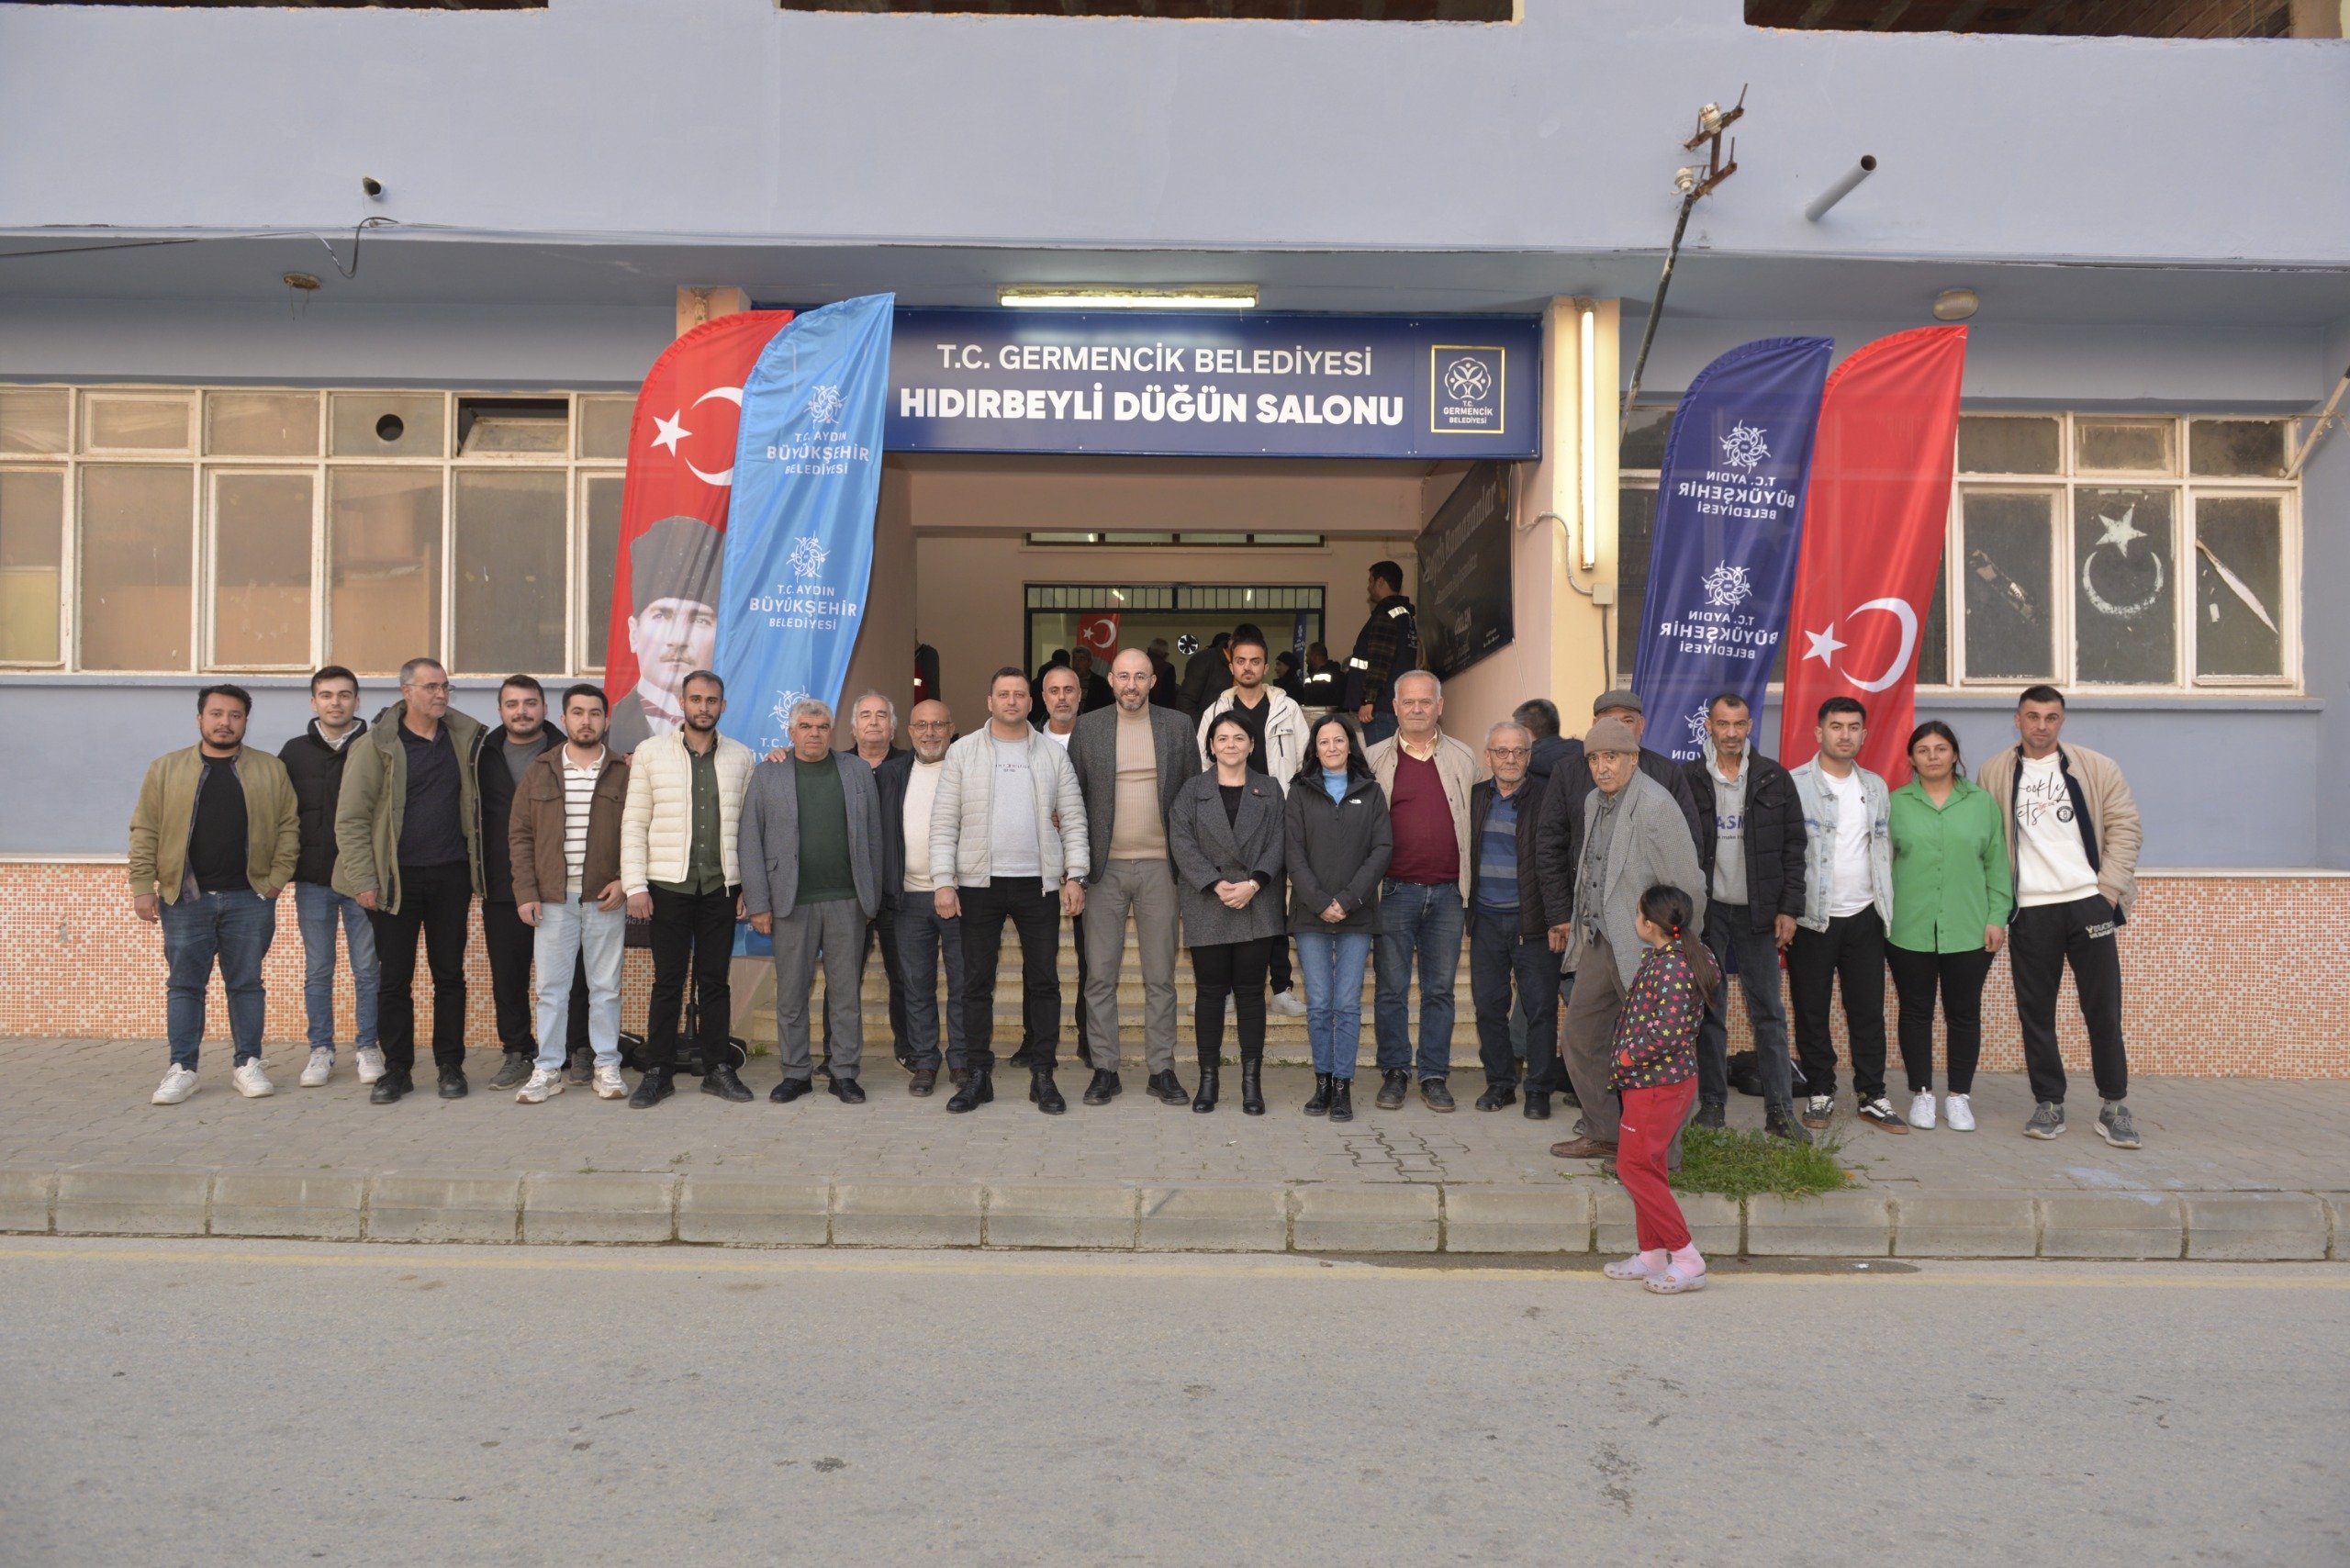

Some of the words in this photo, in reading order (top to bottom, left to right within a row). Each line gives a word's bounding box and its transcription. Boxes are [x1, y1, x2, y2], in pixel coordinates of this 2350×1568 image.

[936, 344, 990, 370] T.C.
[999, 342, 1185, 373] GERMENCİK
[1198, 344, 1372, 376] BELEDİYESİ
[901, 382, 1103, 420] HIDIRBEYLİ
[1113, 384, 1248, 422] DÜĞÜN
[1255, 393, 1404, 426] SALONU
[1443, 407, 1494, 416] GERMENCİK
[1449, 416, 1487, 424] BELEDİYESİ
[795, 432, 810, 442] T.C.
[813, 431, 847, 442] AYDIN
[767, 442, 870, 464] BÜYÜKŞEHİR
[785, 463, 848, 476] BELEDİYESİ
[778, 585, 794, 594] T.C.
[796, 585, 834, 596] AYDIN
[749, 596, 857, 617] BÜYÜKŞEHİR
[769, 617, 837, 631] BELEDİYESİ
[760, 737, 783, 748] T.C.
[2016, 798, 2046, 826] ets
